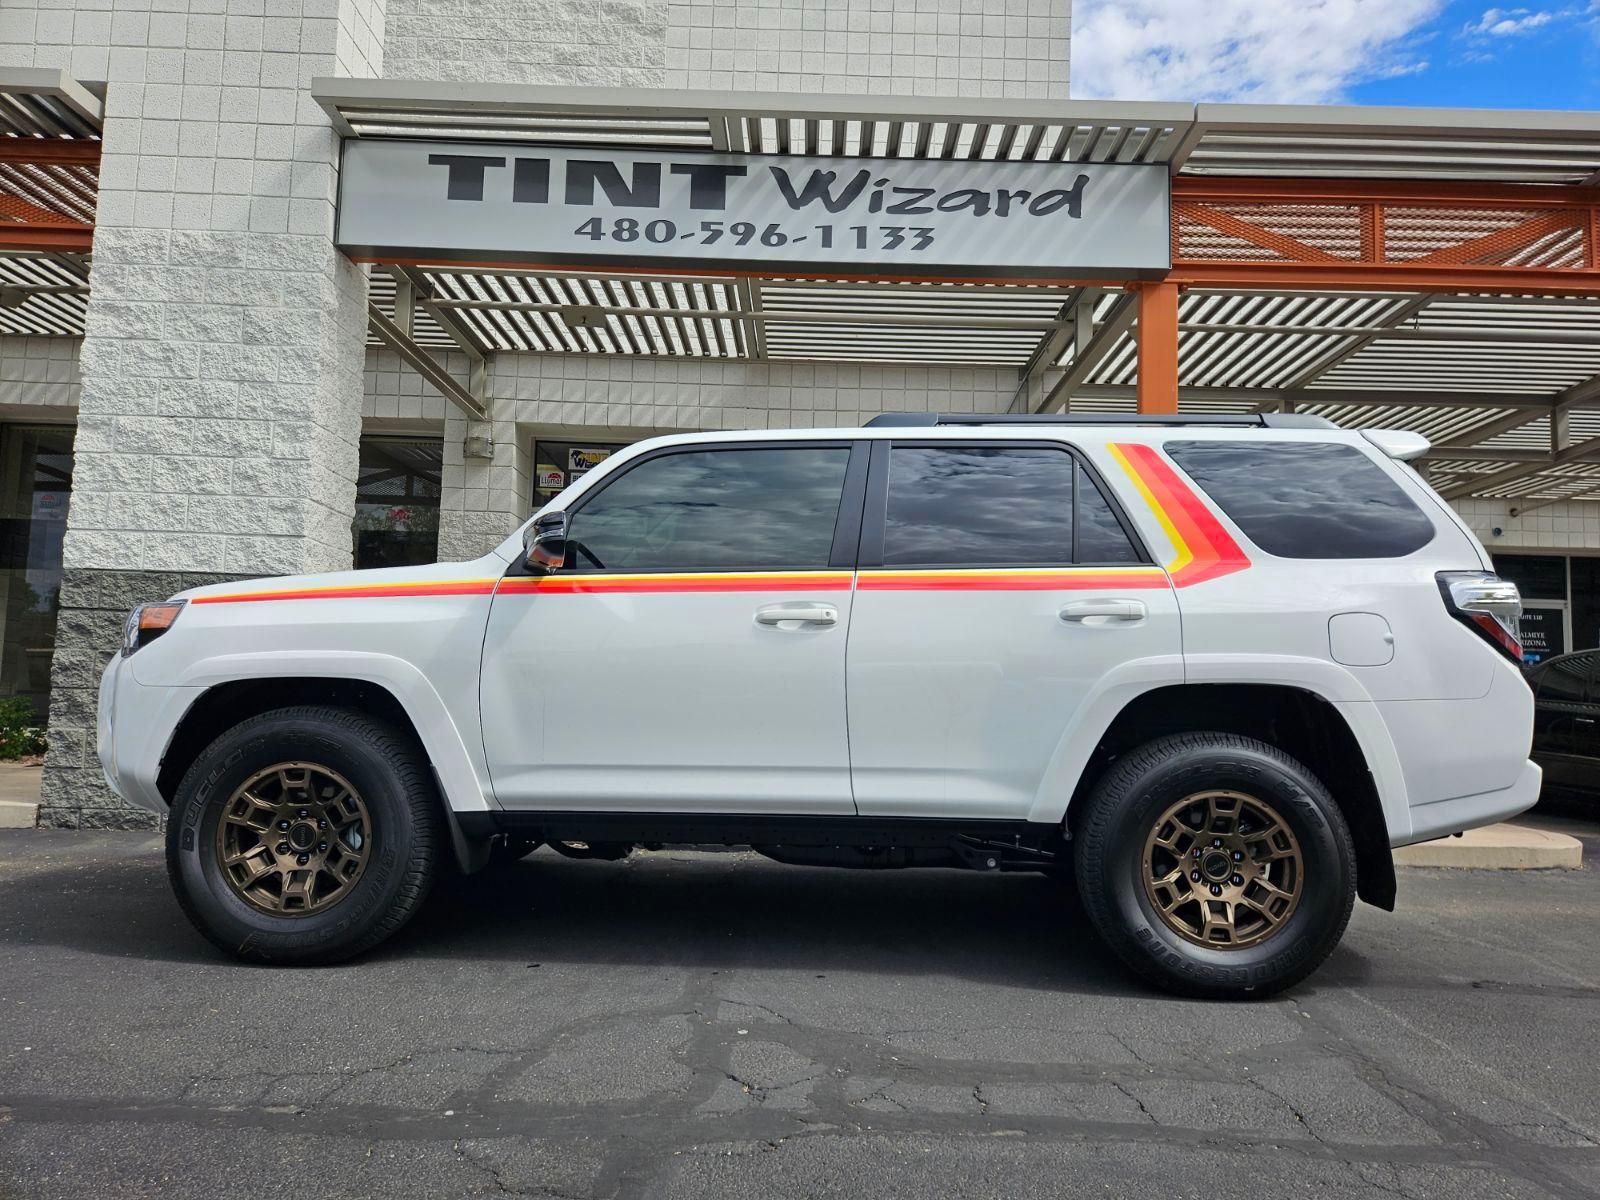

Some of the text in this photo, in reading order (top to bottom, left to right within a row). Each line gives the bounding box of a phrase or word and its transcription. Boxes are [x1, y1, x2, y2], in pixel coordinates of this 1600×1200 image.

[428, 154, 1090, 219] TINT Wizard
[574, 217, 936, 251] 480-596-1133
